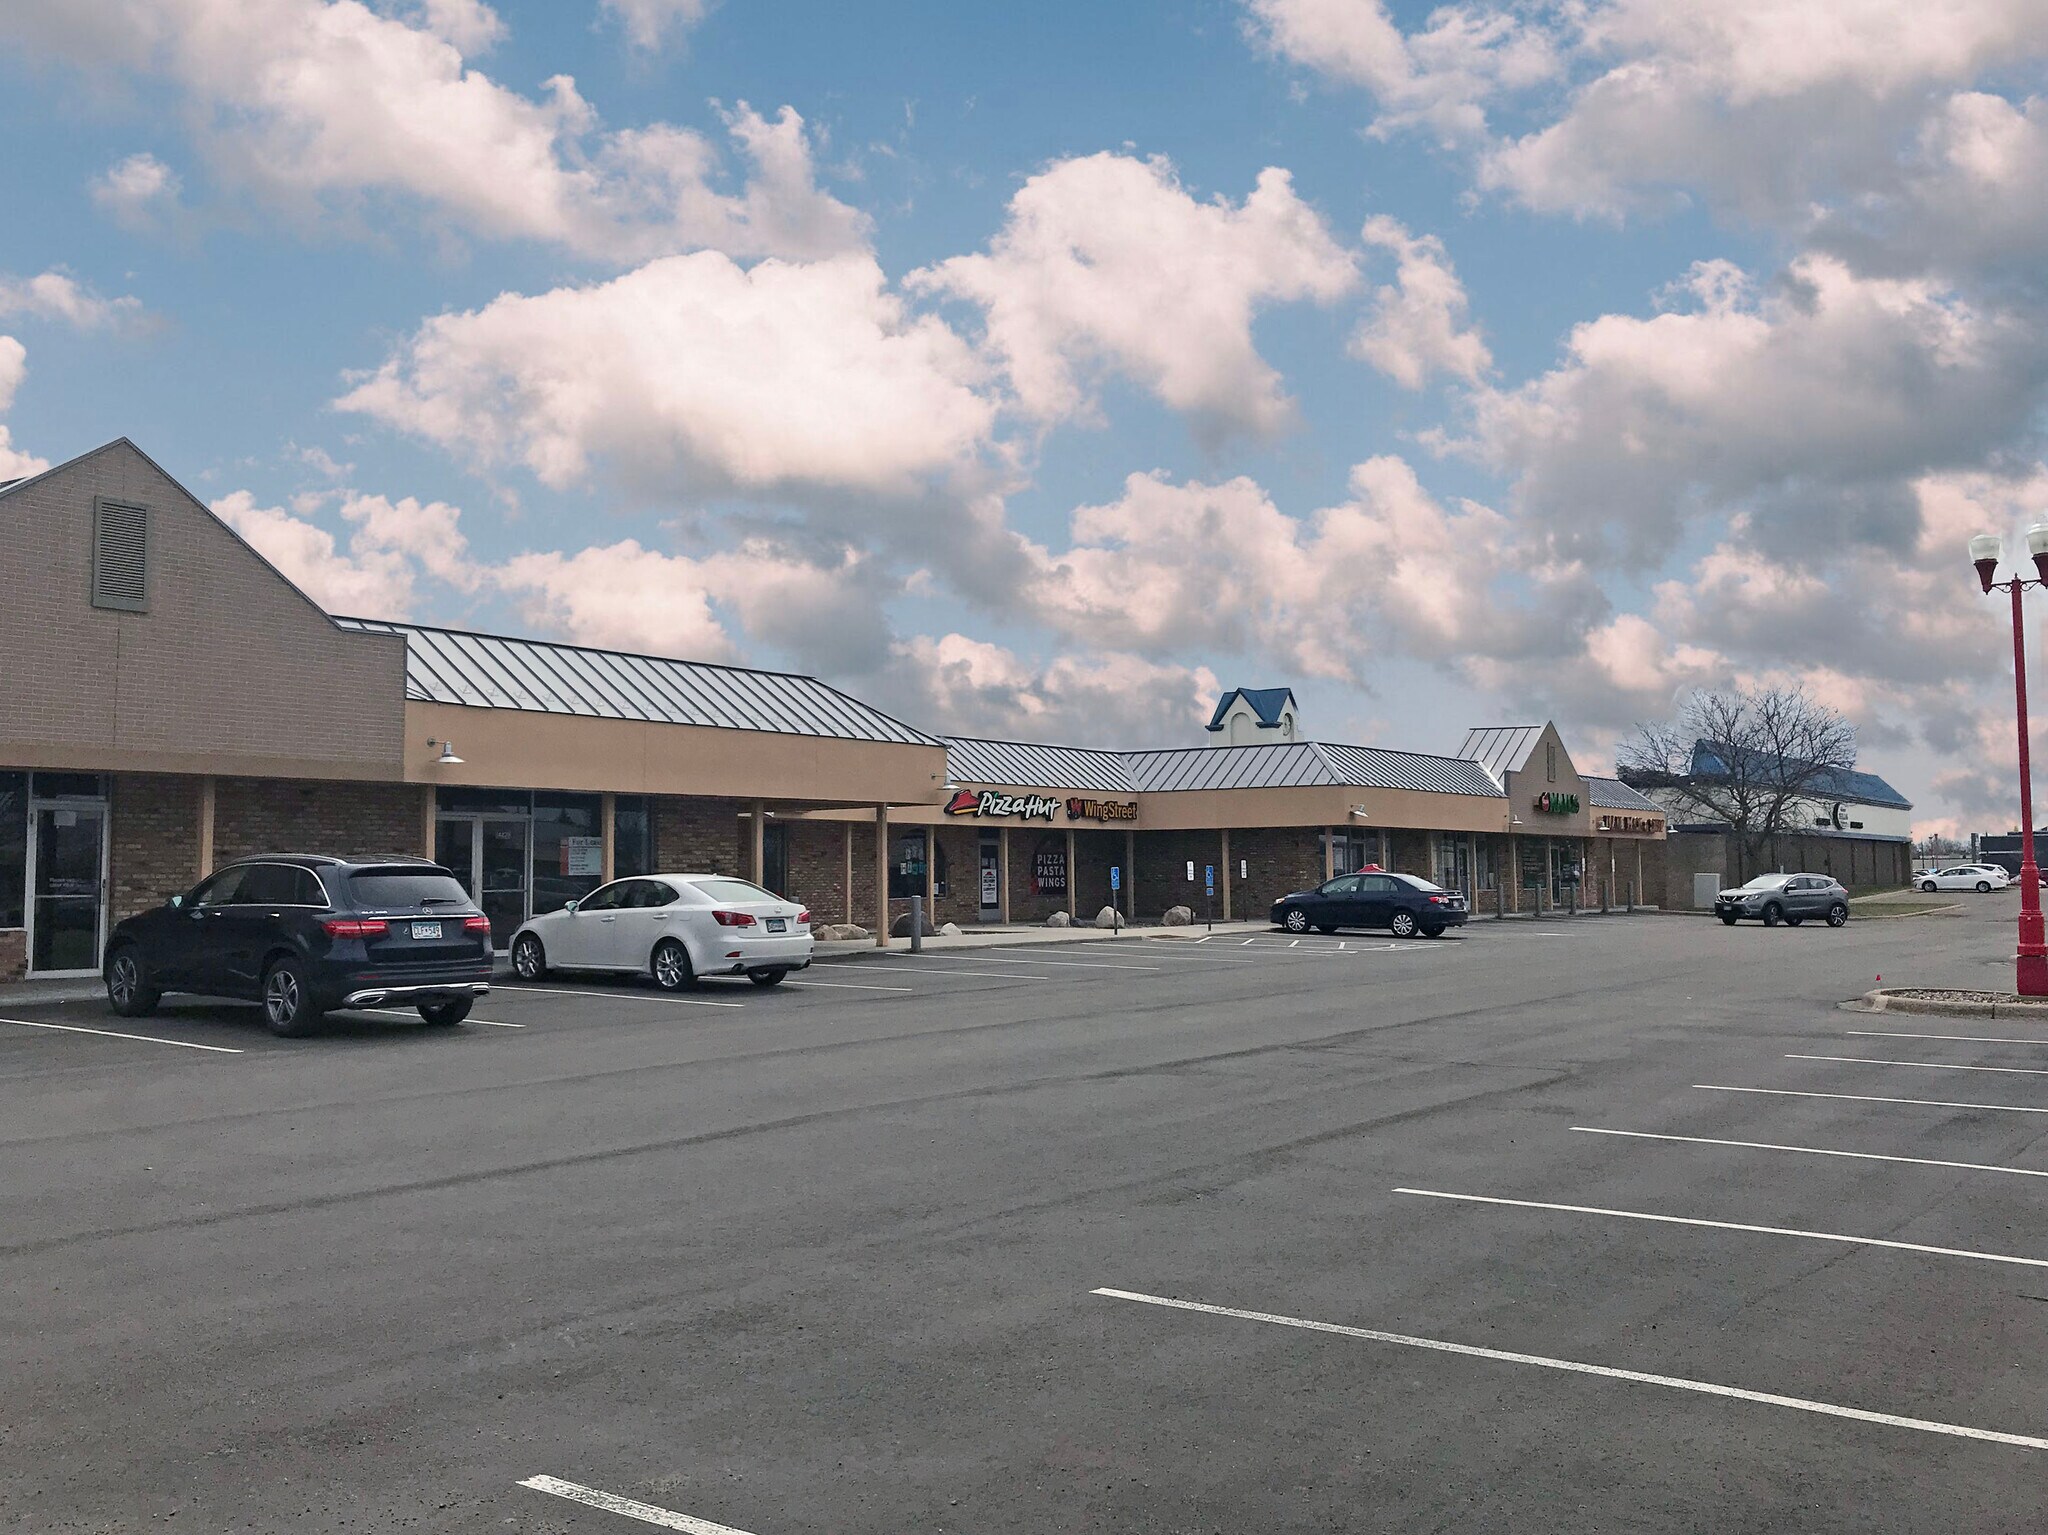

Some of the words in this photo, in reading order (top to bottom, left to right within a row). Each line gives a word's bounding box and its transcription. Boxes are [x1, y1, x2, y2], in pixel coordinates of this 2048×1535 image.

[977, 792, 1025, 817] Pizza
[1023, 795, 1061, 820] Hut
[1084, 799, 1137, 821] WingStreet
[1037, 854, 1065, 864] PIZZA
[1037, 866, 1065, 876] PASTA
[1037, 877, 1066, 887] WINGS
